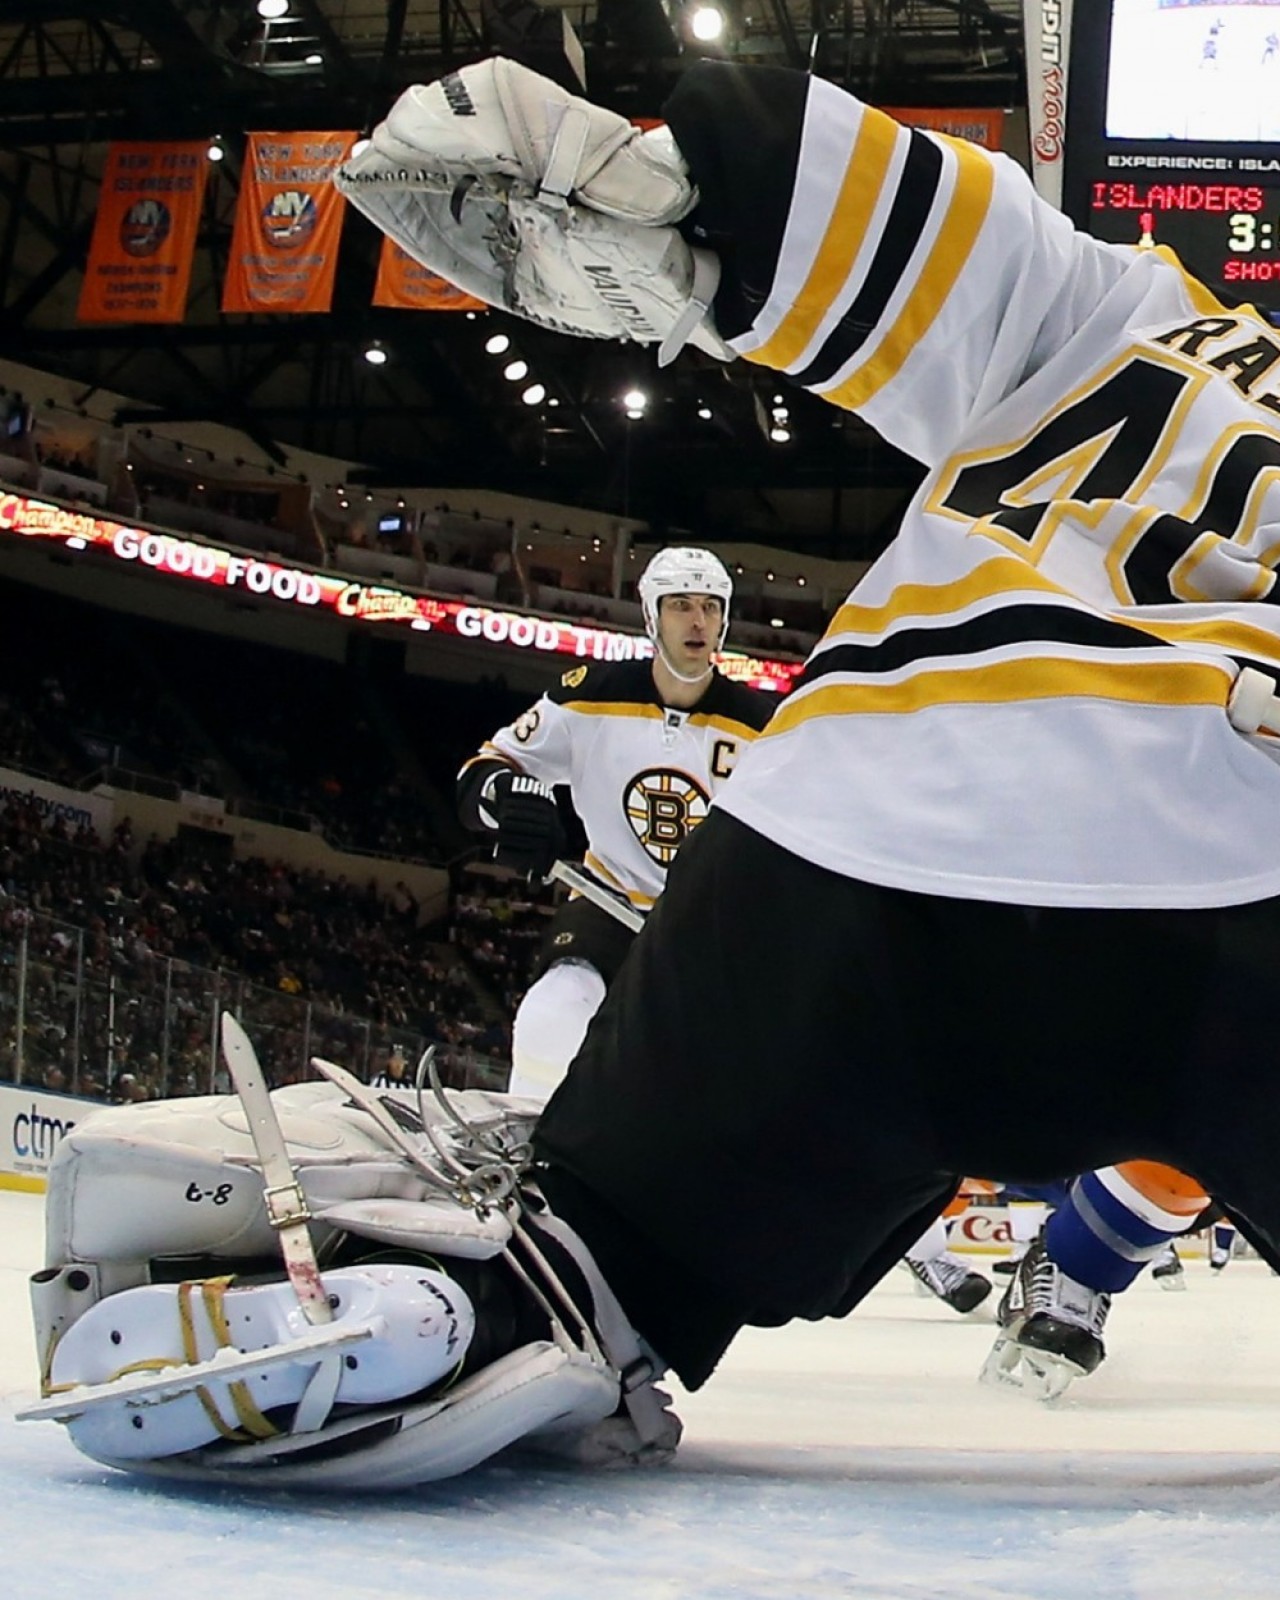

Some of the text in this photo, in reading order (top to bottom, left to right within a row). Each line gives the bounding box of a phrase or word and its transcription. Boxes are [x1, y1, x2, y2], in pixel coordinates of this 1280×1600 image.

[1034, 66, 1063, 164] Coors
[259, 142, 343, 160] NEW YORK
[1108, 155, 1233, 169] EXPERIENCE:
[1092, 183, 1262, 211] ISLANDERS
[113, 528, 216, 578] GOOD
[227, 557, 320, 605] FOOD
[456, 607, 560, 650] GOOD
[571, 627, 655, 661] TIME
[711, 740, 735, 778] C
